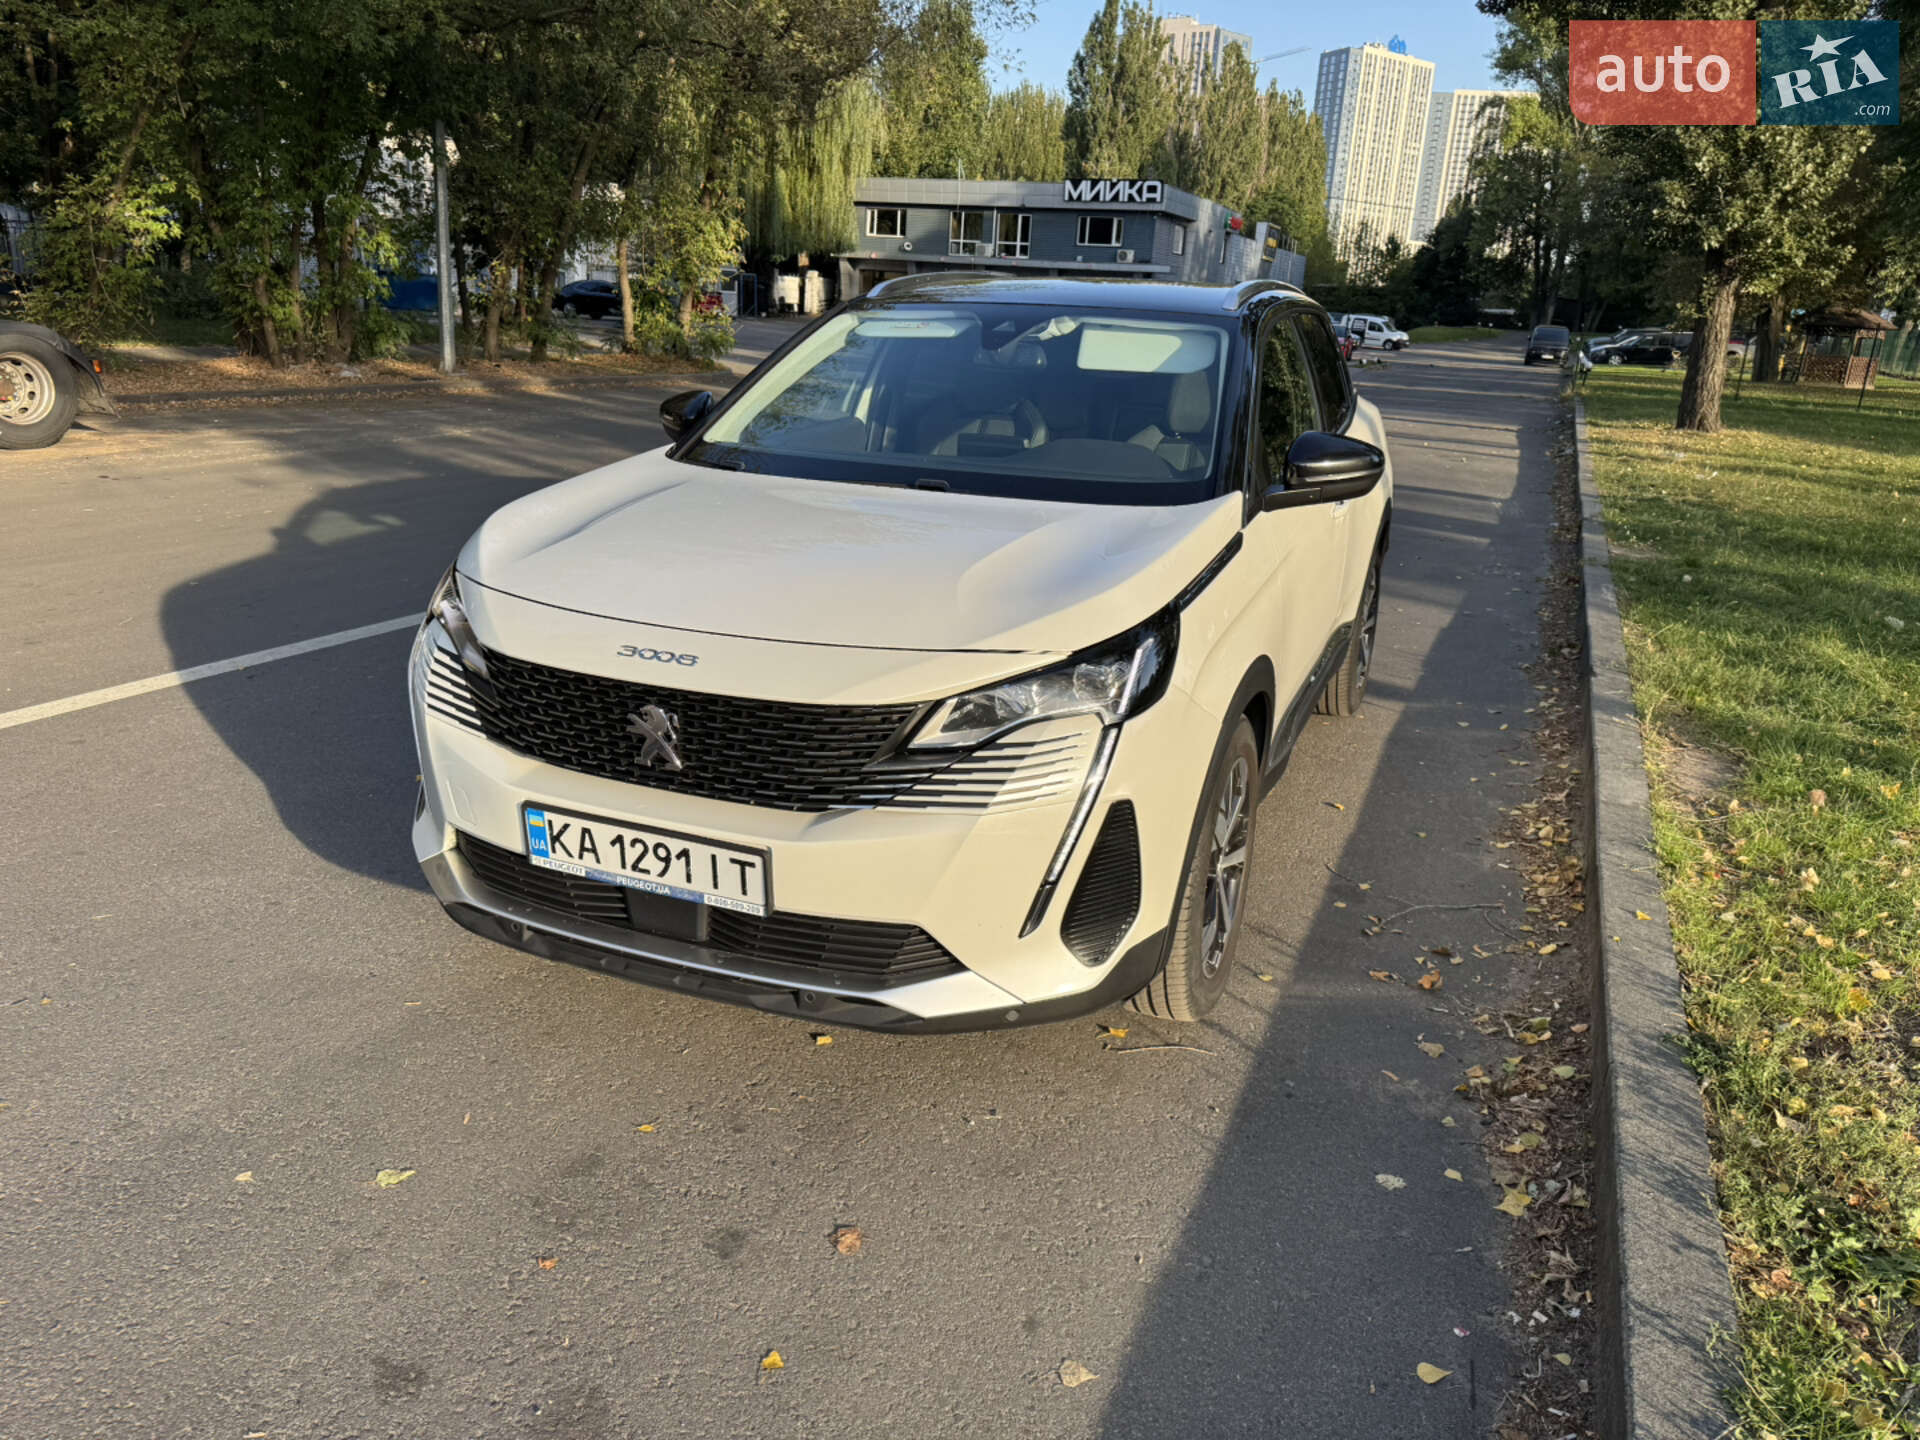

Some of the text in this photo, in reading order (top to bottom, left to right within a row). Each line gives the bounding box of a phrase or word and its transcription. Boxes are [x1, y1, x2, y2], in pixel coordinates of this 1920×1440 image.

[1064, 177, 1162, 202] МИЙКА
[617, 645, 699, 667] 3008
[531, 837, 548, 850] UA
[547, 819, 756, 896] KA 1291 IT
